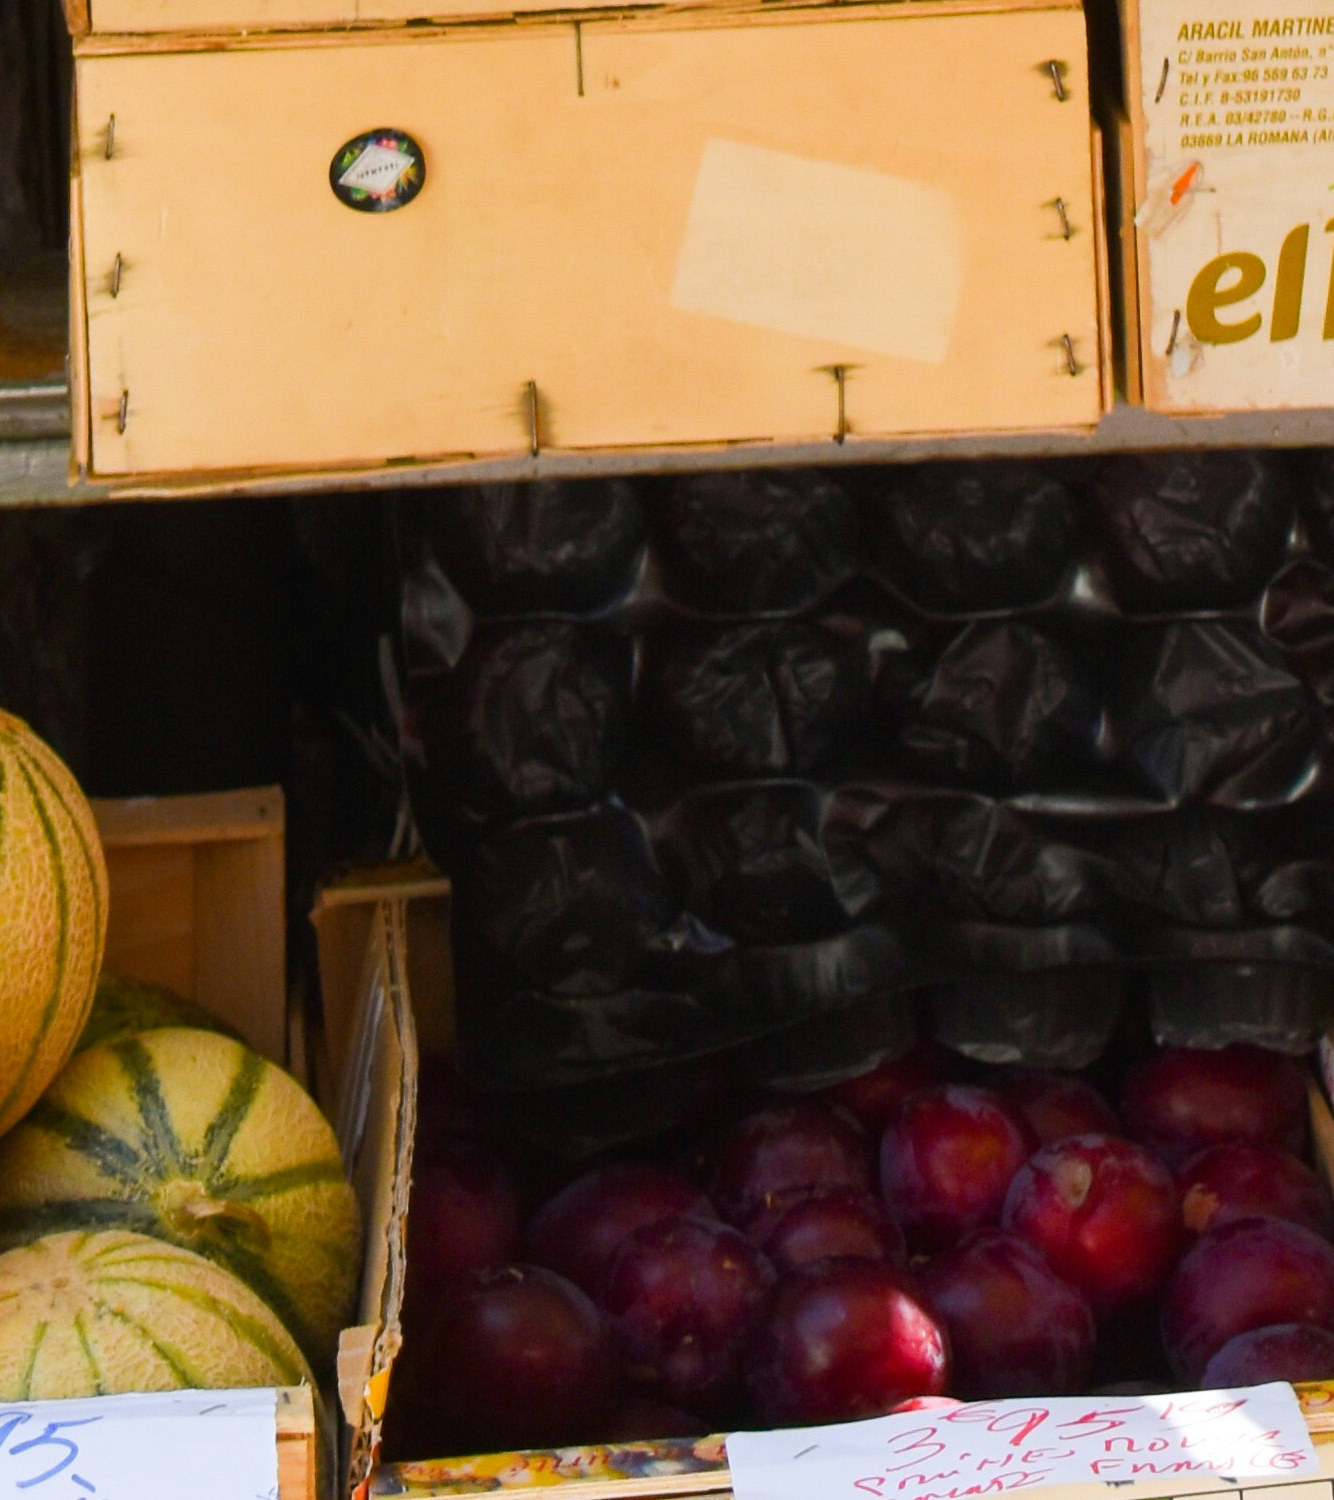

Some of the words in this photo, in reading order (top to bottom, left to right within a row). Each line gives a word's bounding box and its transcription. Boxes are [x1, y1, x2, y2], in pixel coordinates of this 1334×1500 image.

[1177, 19, 1245, 42] ARACIL
[1241, 46, 1267, 62] San
[1226, 132, 1244, 147] LA
[1247, 130, 1309, 147] ROMANA
